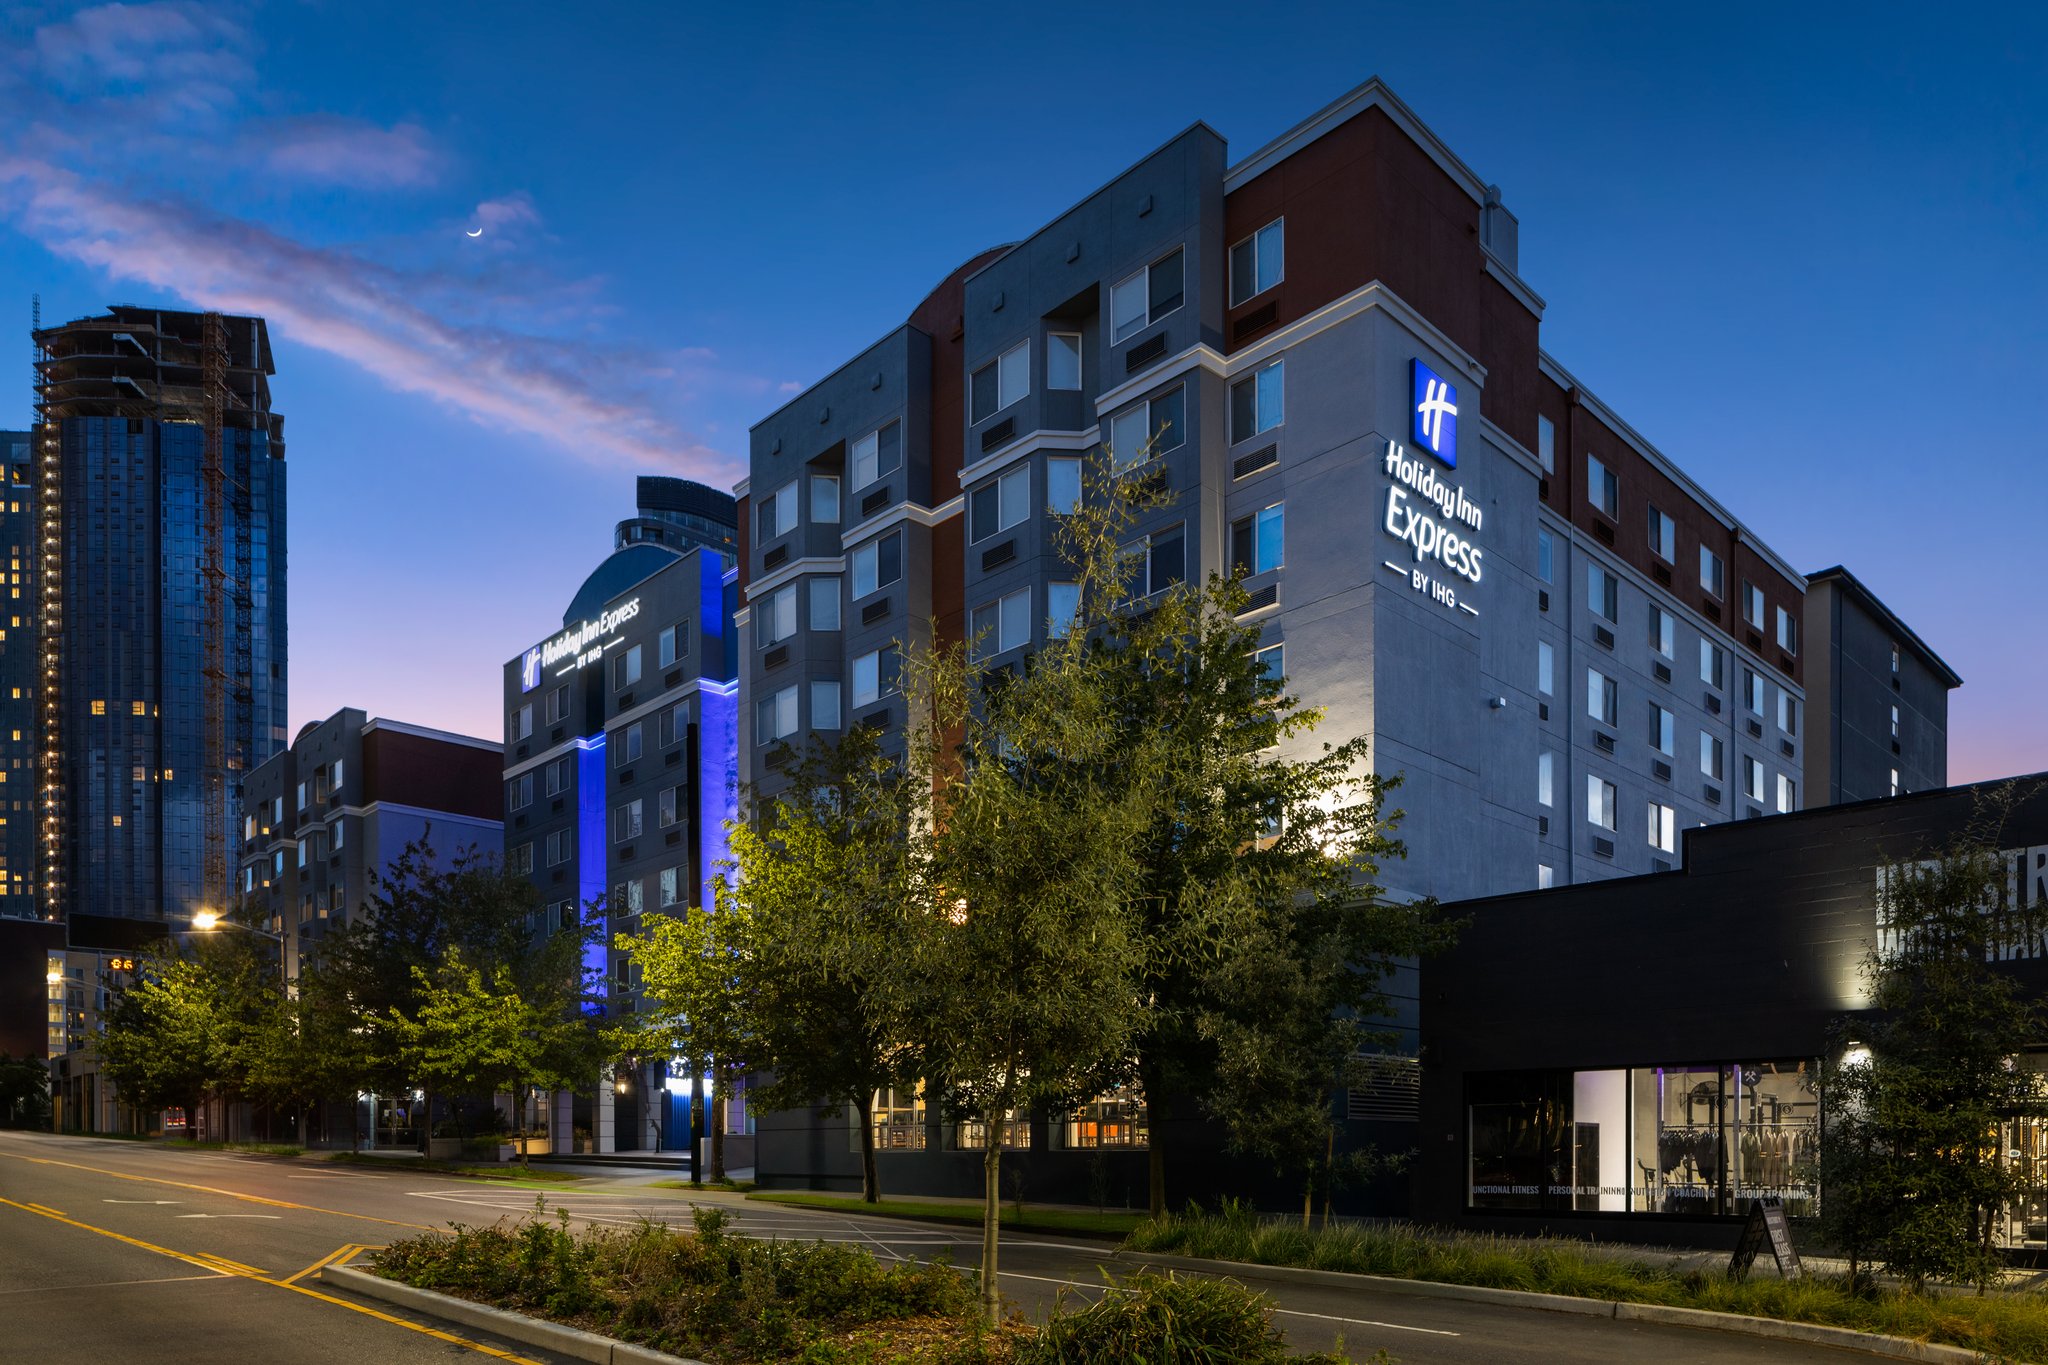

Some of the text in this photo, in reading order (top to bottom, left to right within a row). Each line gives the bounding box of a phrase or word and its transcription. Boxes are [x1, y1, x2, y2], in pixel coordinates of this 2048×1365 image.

[1386, 440, 1482, 530] Holiday Inn
[1386, 485, 1482, 583] Express
[1412, 569, 1455, 608] BY IHG
[542, 598, 639, 667] Holiday Inn Express
[577, 646, 602, 669] BY IHG
[1471, 1184, 1540, 1195] UNCTIONAL FITNESS
[1734, 1189, 1764, 1199] GROUP
